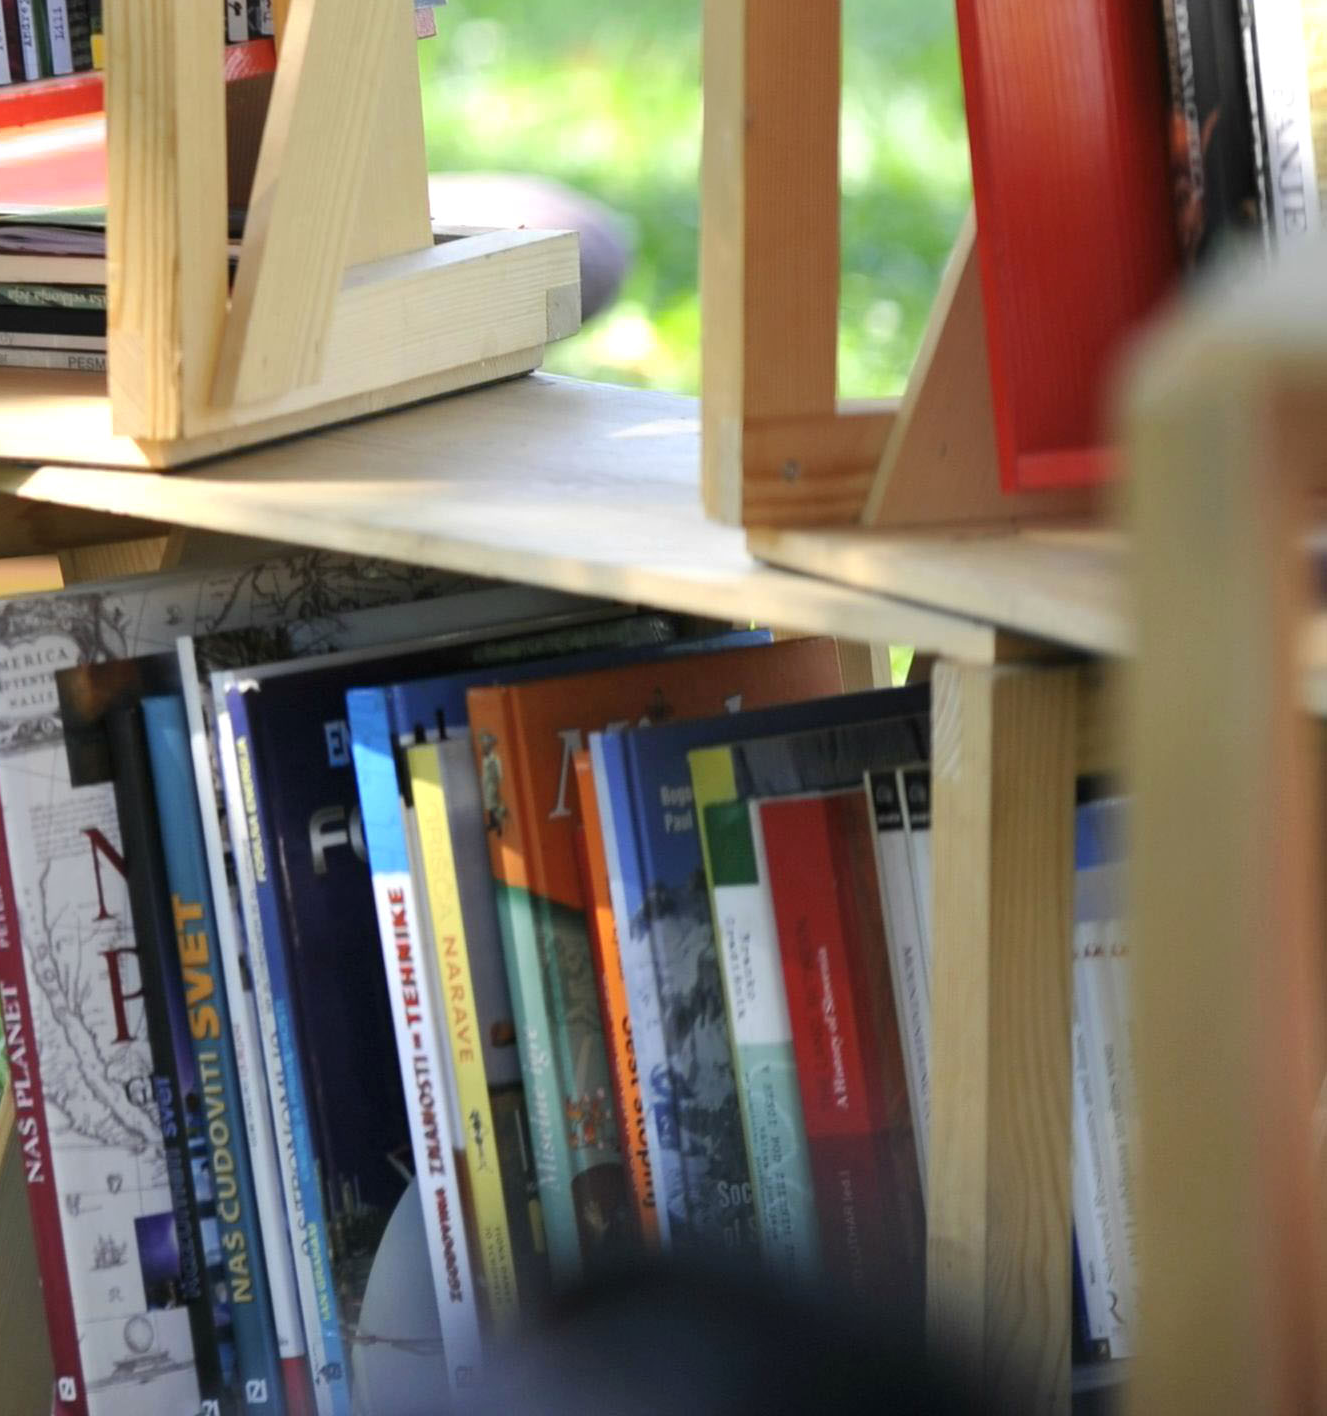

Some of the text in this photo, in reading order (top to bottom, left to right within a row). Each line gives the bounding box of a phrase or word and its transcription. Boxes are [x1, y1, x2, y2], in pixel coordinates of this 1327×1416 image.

[51, 6, 66, 39] Lili
[386, 885, 423, 1028] TEHNIKE
[440, 934, 475, 1064] NARAVE
[813, 945, 836, 1014] Slovenia
[169, 889, 254, 1304] NAŠ ČUDOVITI SVET
[827, 1034, 850, 1086] History
[16, 1112, 47, 1184] NAŠ
[412, 1054, 446, 1176] ZNANOSTI
